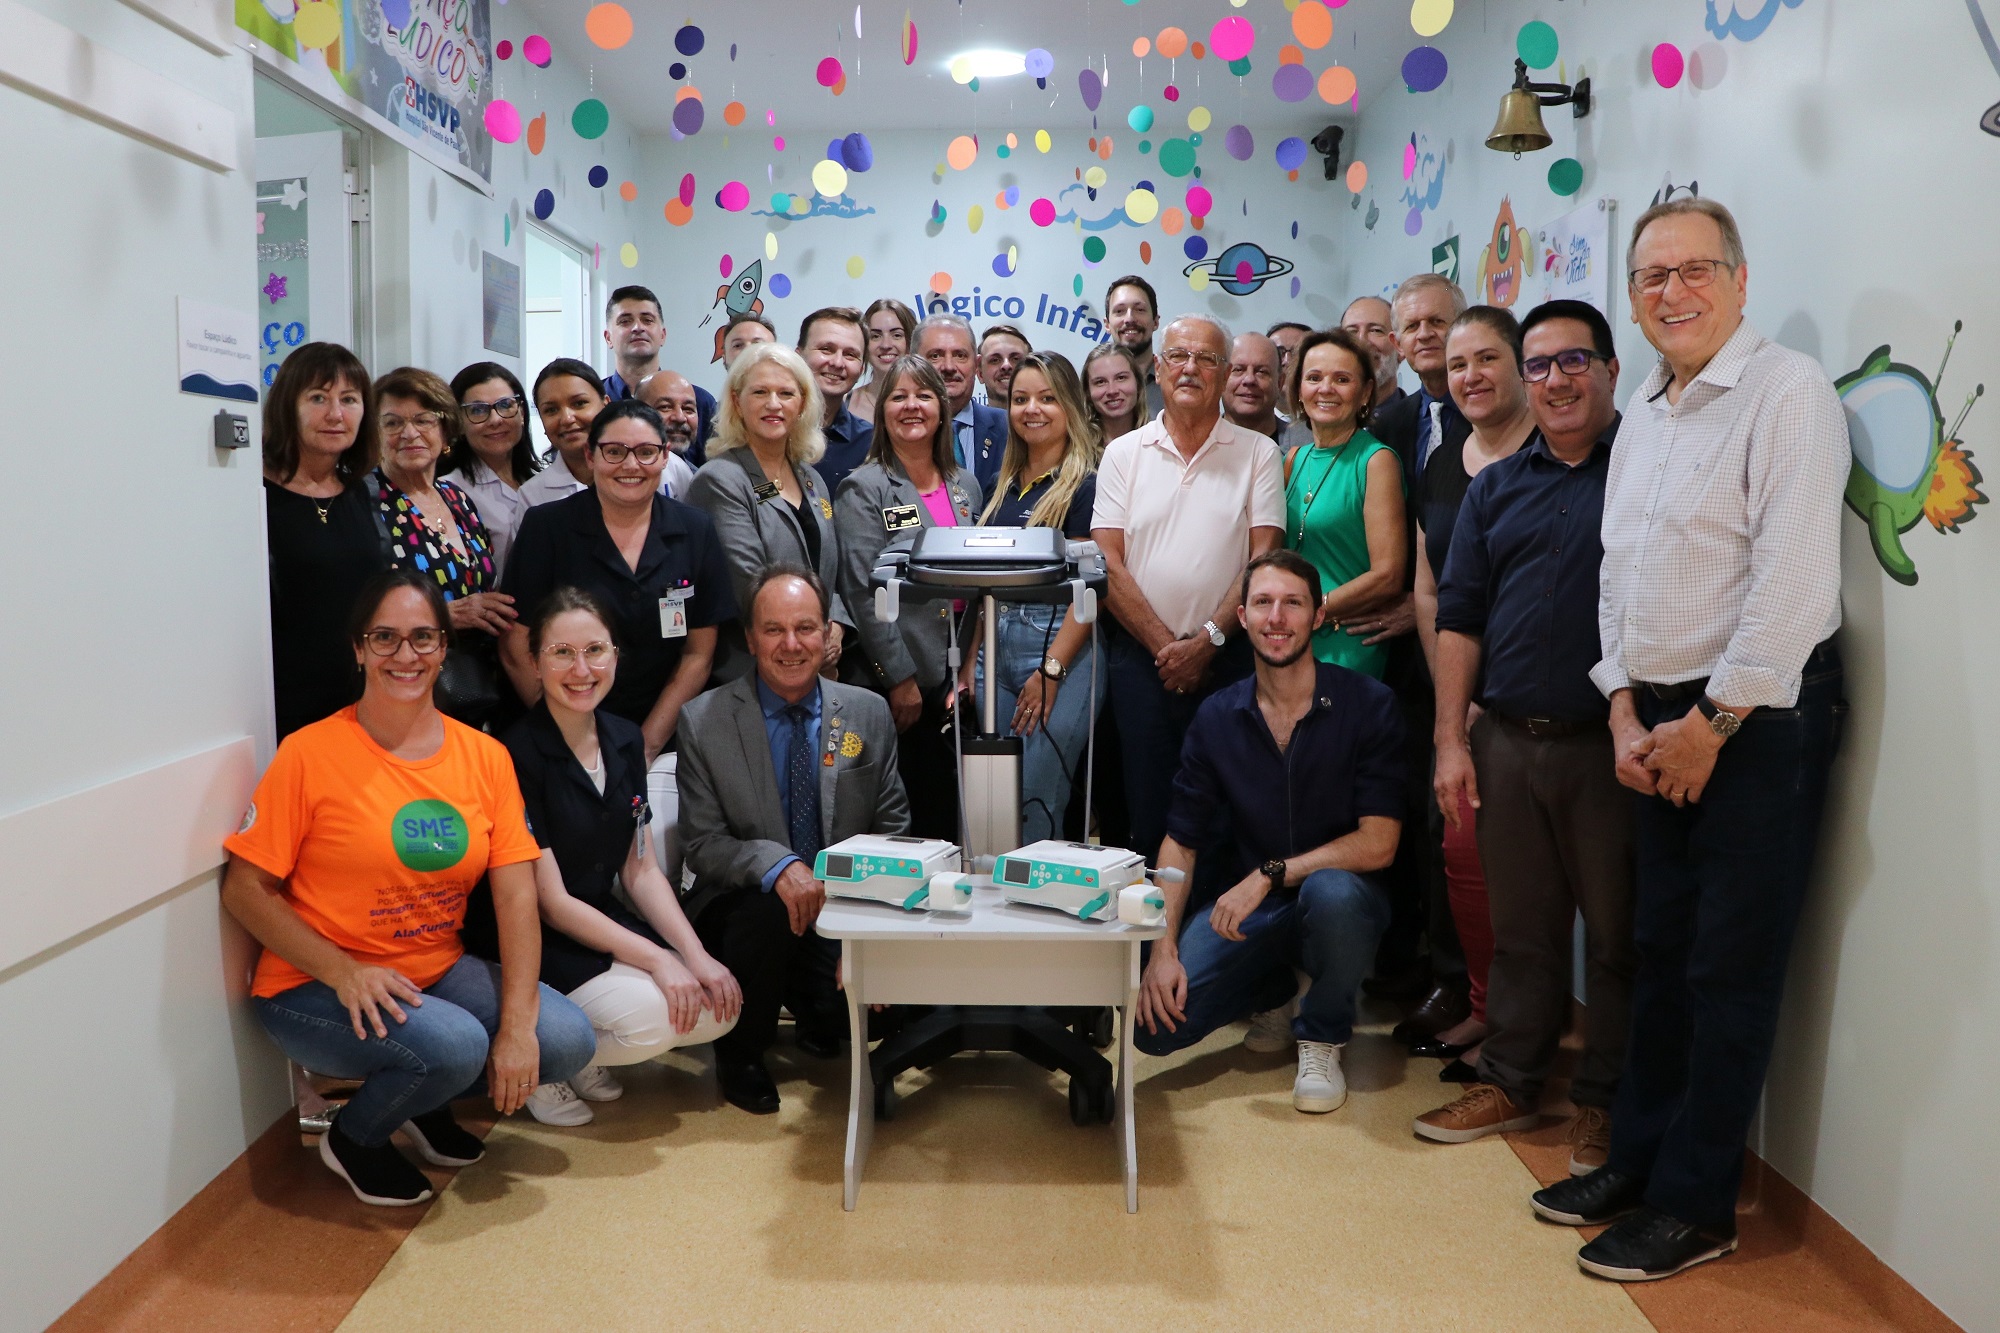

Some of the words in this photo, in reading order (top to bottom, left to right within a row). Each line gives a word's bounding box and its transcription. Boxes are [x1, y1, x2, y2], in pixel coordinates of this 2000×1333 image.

[416, 82, 460, 133] HSVP
[1565, 256, 1587, 285] Vida
[909, 285, 1025, 322] lógico
[403, 816, 457, 839] SME
[371, 917, 389, 927] QUE
[393, 928, 421, 939] Alan
[420, 919, 455, 932] Turing
